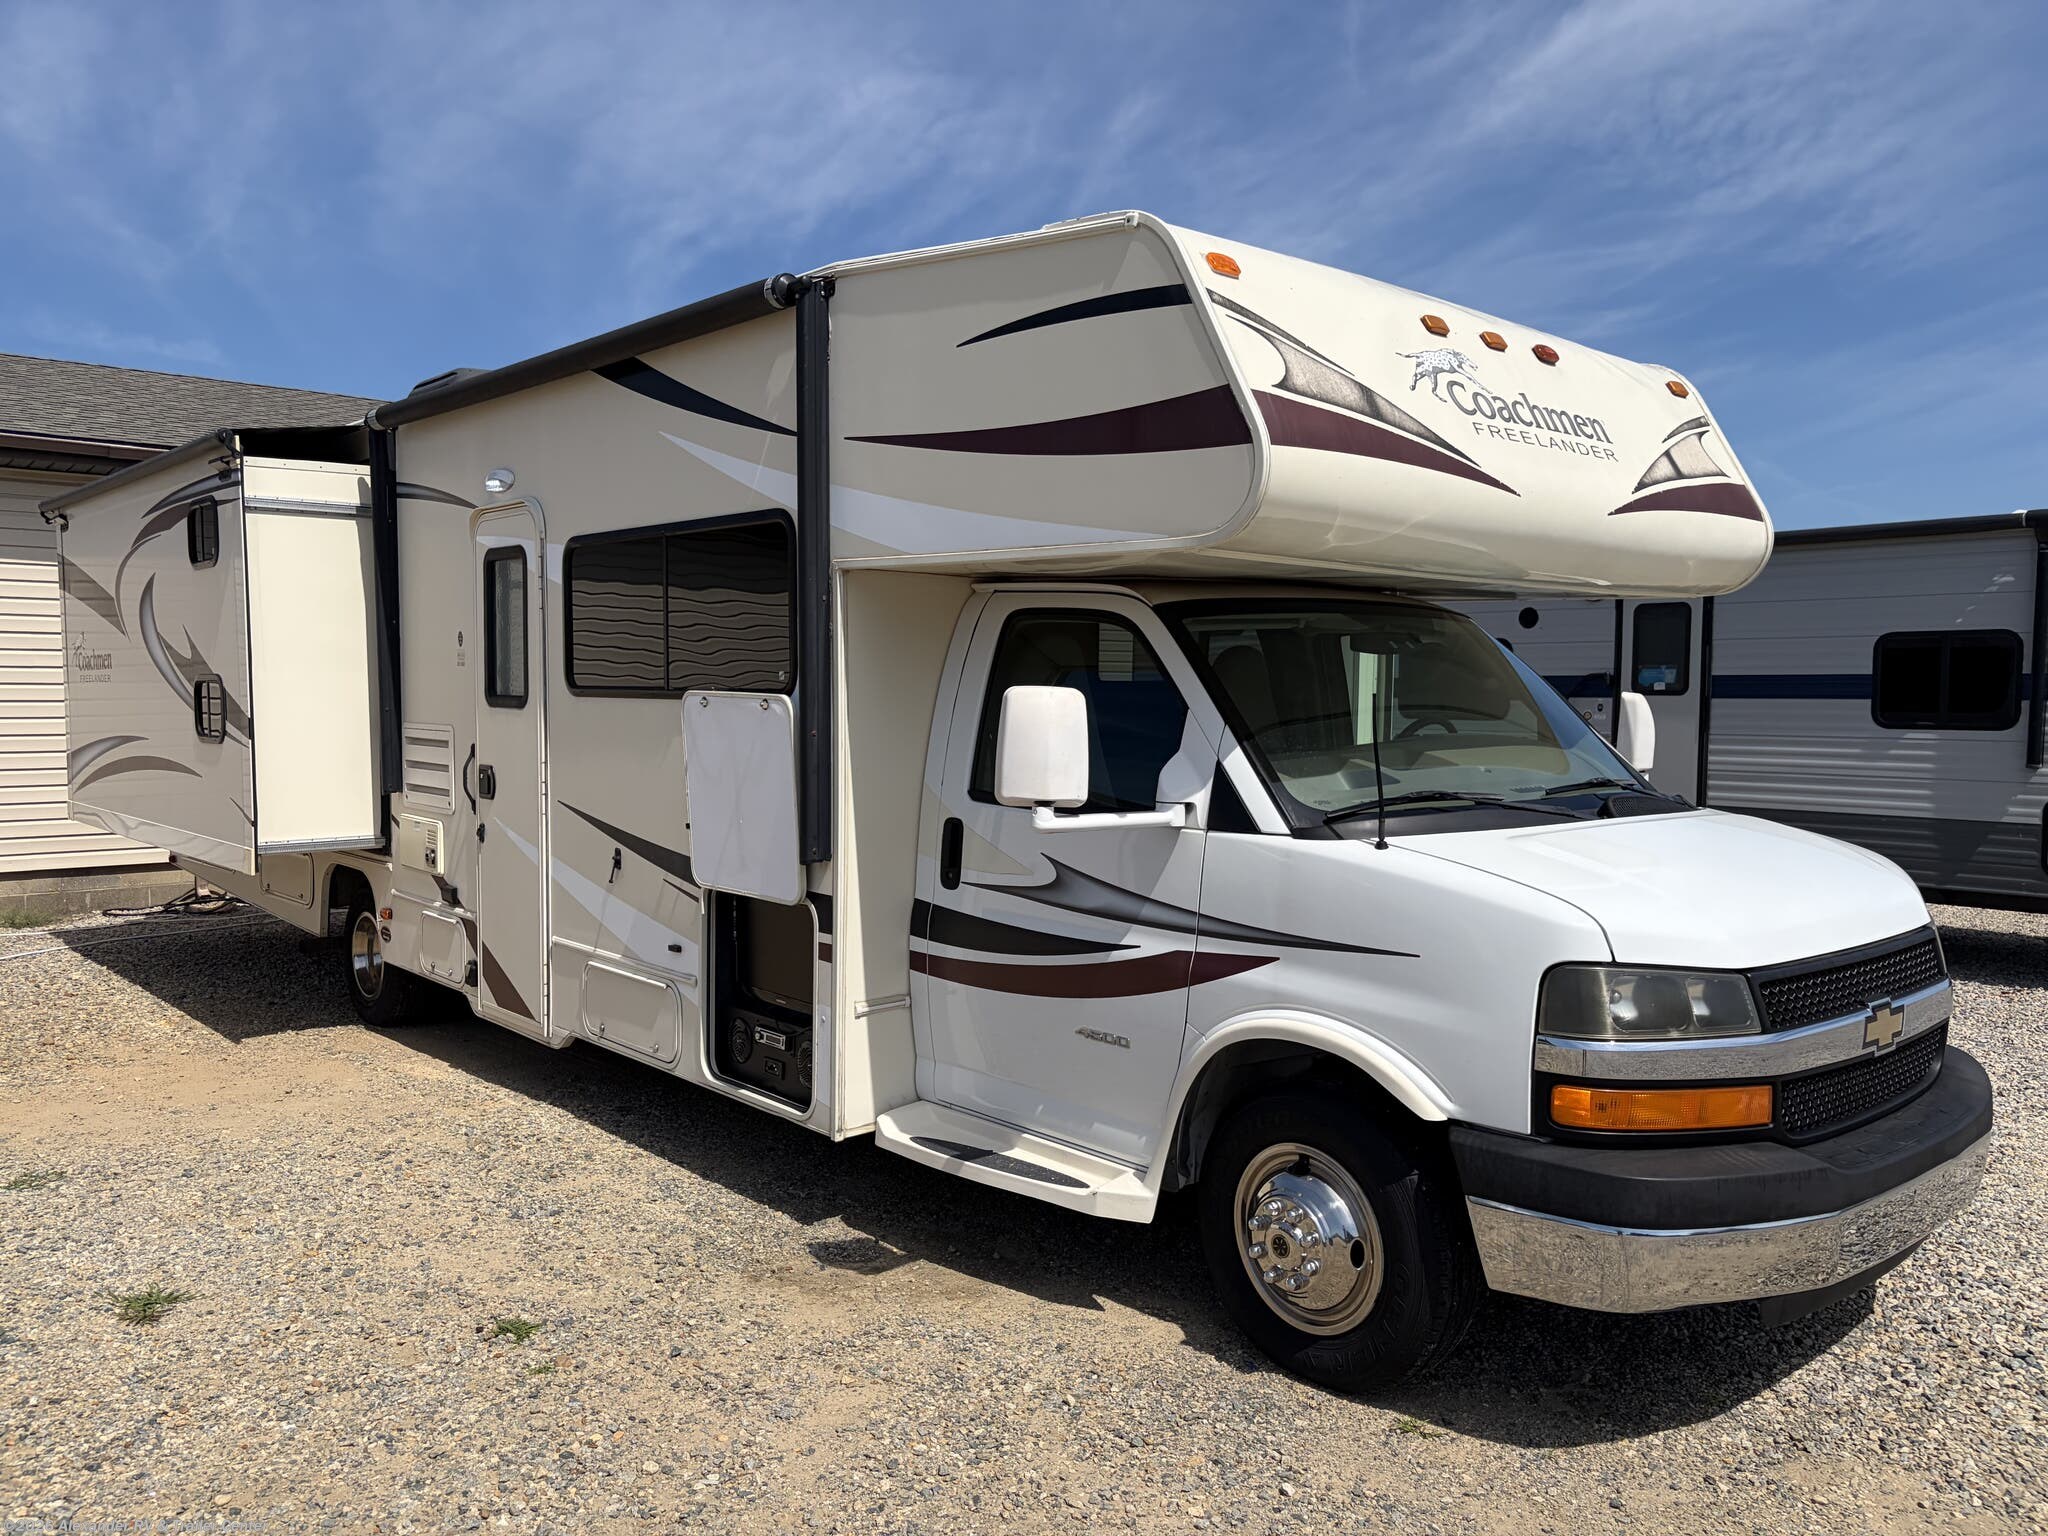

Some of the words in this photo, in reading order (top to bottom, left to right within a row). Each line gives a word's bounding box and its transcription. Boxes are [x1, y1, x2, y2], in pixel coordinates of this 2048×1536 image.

[1446, 380, 1614, 445] Coachmen
[1472, 421, 1619, 462] FREELANDER
[78, 648, 113, 671] Coachmen
